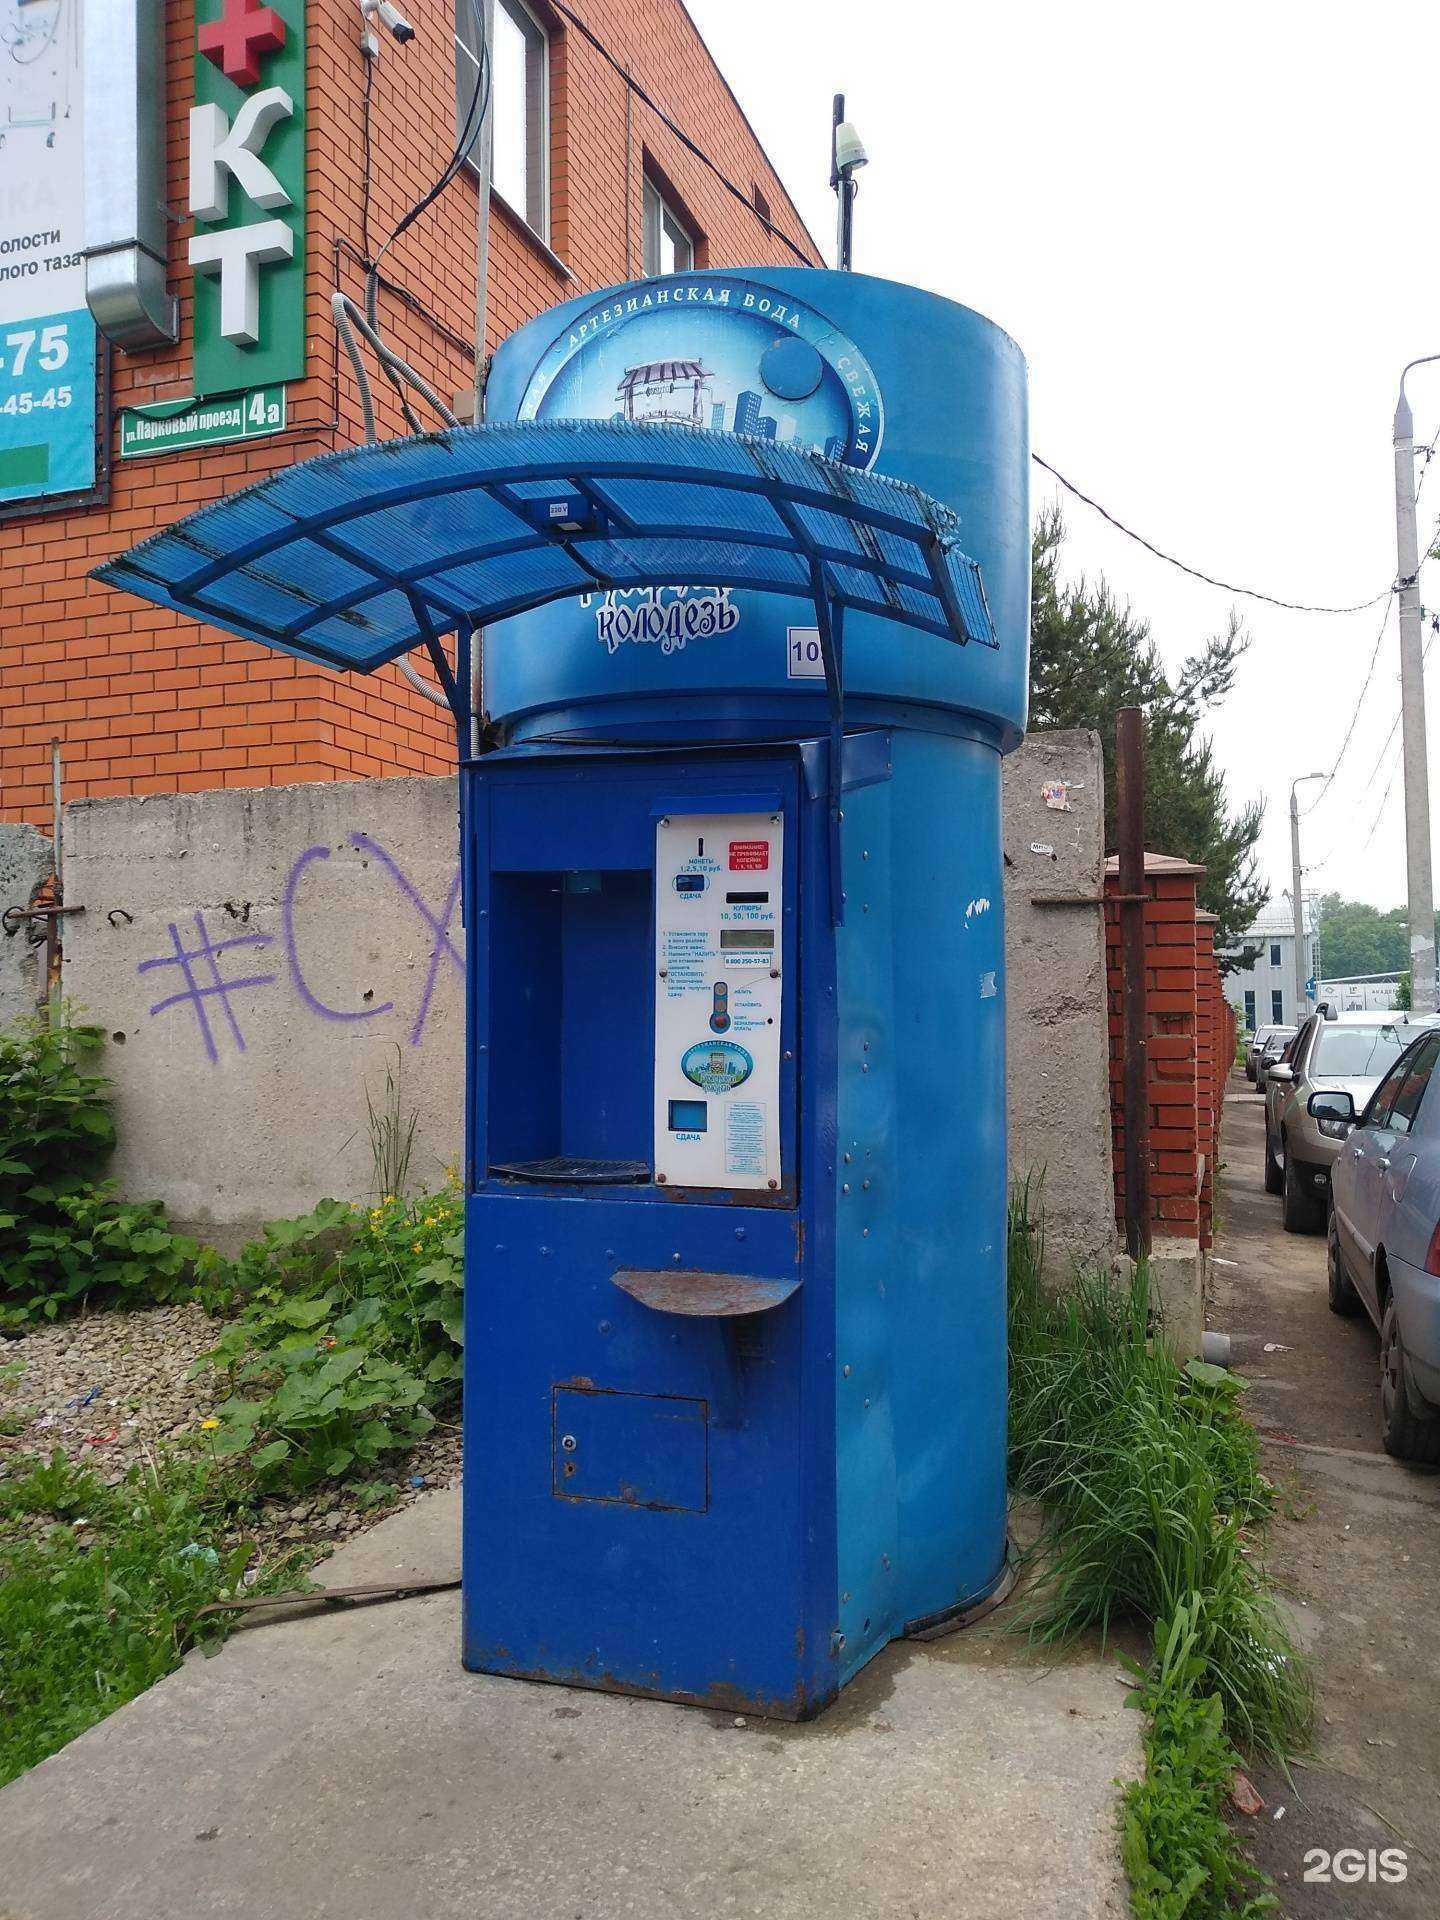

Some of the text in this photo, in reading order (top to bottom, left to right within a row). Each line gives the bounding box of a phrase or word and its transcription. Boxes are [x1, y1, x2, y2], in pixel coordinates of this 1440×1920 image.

[43, 252, 83, 273] таза
[0, 324, 69, 377] 75
[568, 287, 732, 348] АРТЕЗИАНСКАЯ
[743, 293, 801, 330] ВОДА
[837, 357, 872, 454] СВЕЖАЯ
[137, 413, 199, 440] Парковый
[200, 409, 240, 430] проезд
[792, 641, 823, 662] 10
[760, 913, 775, 921] руб.
[675, 1133, 701, 1141] СДАЧА
